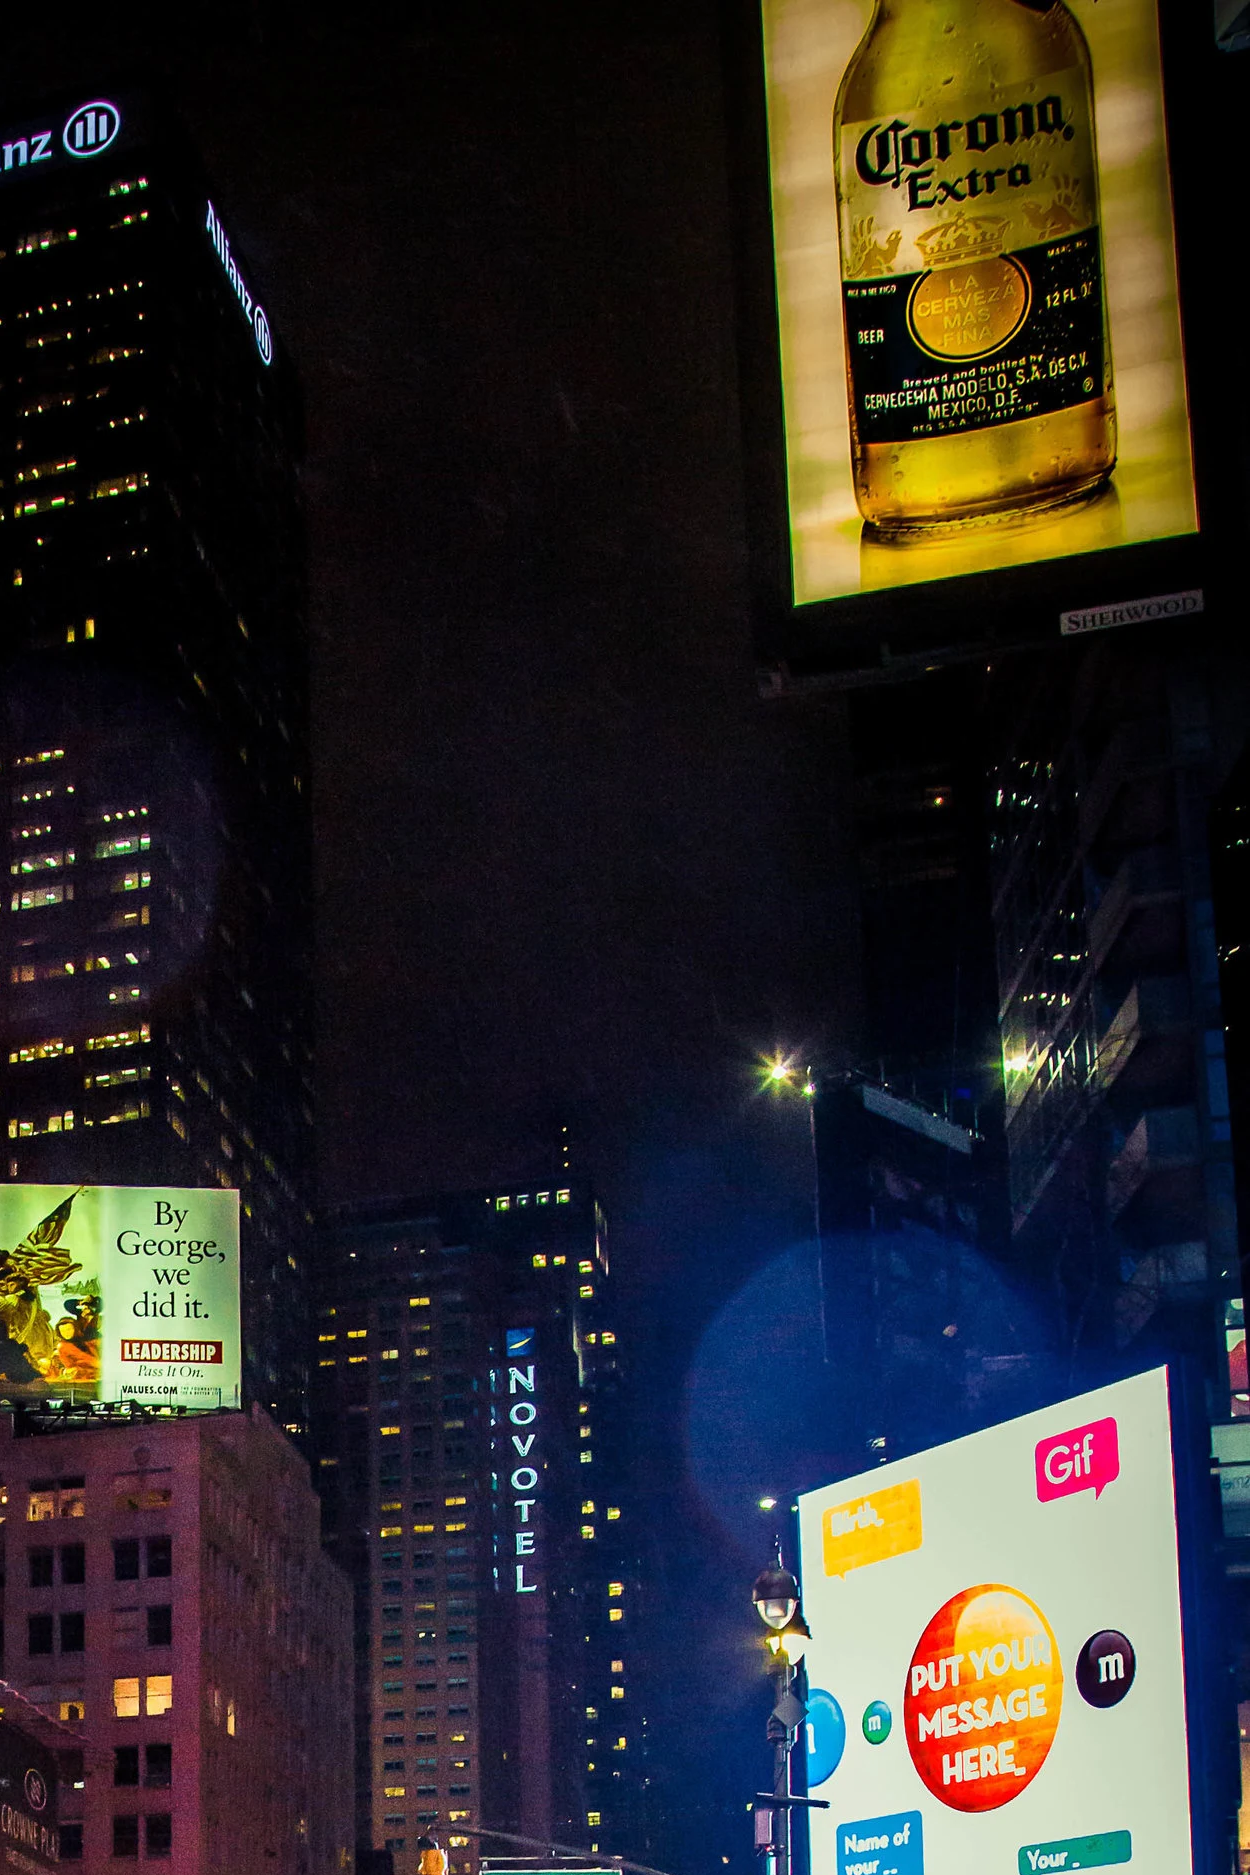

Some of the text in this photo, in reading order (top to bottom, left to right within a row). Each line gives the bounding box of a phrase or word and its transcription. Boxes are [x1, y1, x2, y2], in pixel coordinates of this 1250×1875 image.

[856, 94, 1066, 189] Corona
[907, 163, 1033, 214] Extra
[206, 200, 252, 323] Allianz
[950, 275, 978, 293] LA
[1045, 290, 1061, 310] 12
[916, 285, 1016, 318] CERVEZA
[943, 308, 991, 330] MAS
[857, 329, 884, 345] BEER
[943, 325, 994, 348] FINA
[864, 386, 939, 411] CERVECERIA
[941, 373, 1013, 400] MODELO,
[1048, 358, 1066, 378] DE
[902, 372, 948, 390] Brewed
[952, 367, 976, 382] and
[979, 356, 1026, 375] bottled
[928, 396, 992, 421] MEXICO,
[1066, 596, 1199, 633] SHERWOOD
[154, 1200, 189, 1233] By
[116, 1229, 226, 1265] George,
[152, 1267, 190, 1286] we
[132, 1291, 210, 1320] did it.
[123, 1341, 216, 1362] LEADERSHIP
[138, 1364, 204, 1378] Pass It On.
[122, 1385, 178, 1396] VALUES.COM
[1044, 1433, 1094, 1485] Gif
[507, 1365, 538, 1593] NOVOTEL
[910, 1633, 1052, 1696] PUT YOUR
[1098, 1649, 1125, 1684] m
[867, 1714, 882, 1732] m
[918, 1684, 1048, 1742] MESSAGE
[2, 1804, 38, 1850] CROWNE
[844, 1823, 911, 1856] Name of
[1027, 1849, 1068, 1871] Your
